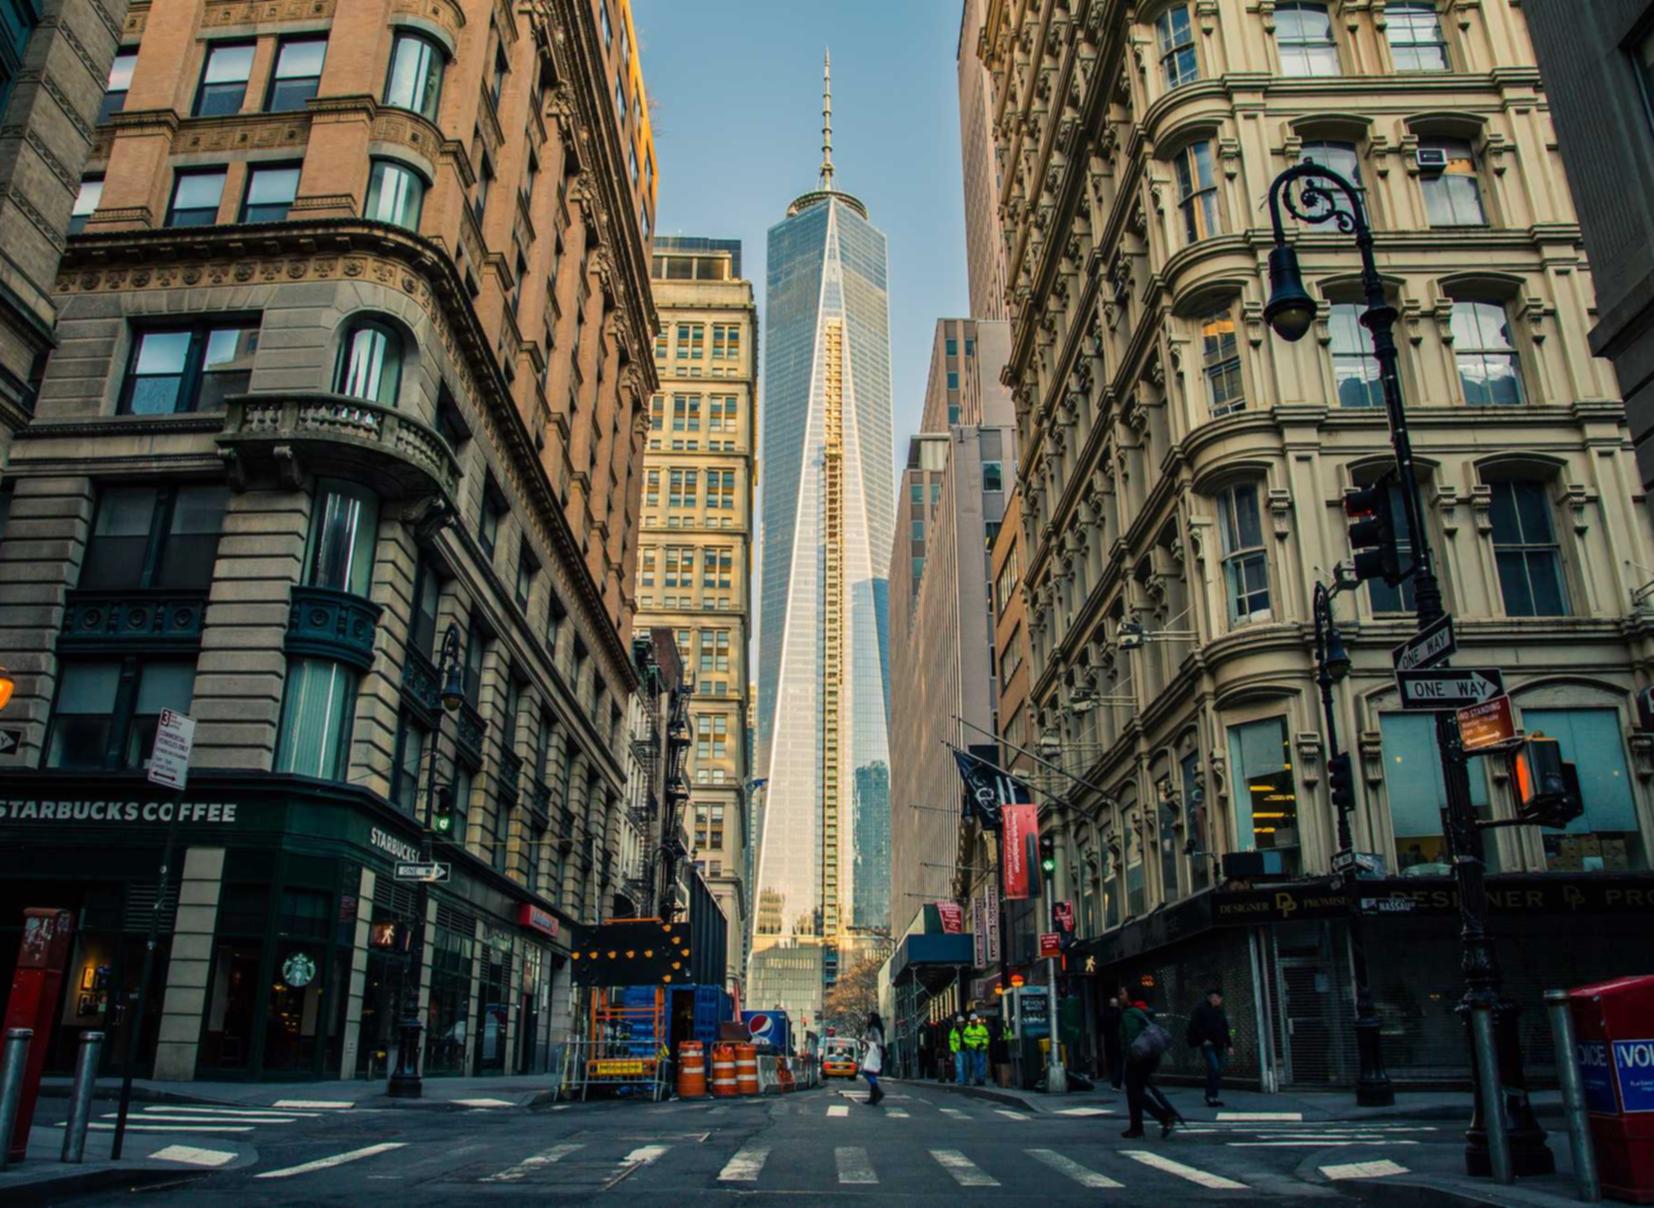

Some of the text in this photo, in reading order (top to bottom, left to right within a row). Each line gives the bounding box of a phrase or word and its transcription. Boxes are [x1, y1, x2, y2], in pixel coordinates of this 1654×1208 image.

[1402, 631, 1446, 669] ONE WAY
[1414, 681, 1487, 697] ONE WAY
[1471, 702, 1502, 717] STANDING
[0, 800, 237, 822] STARBUCKS COFFEE
[370, 827, 416, 862] STARBUCKS
[1378, 901, 1410, 911] NASSAU
[1390, 890, 1545, 908] DESINER
[1219, 902, 1270, 914] DESIGNER
